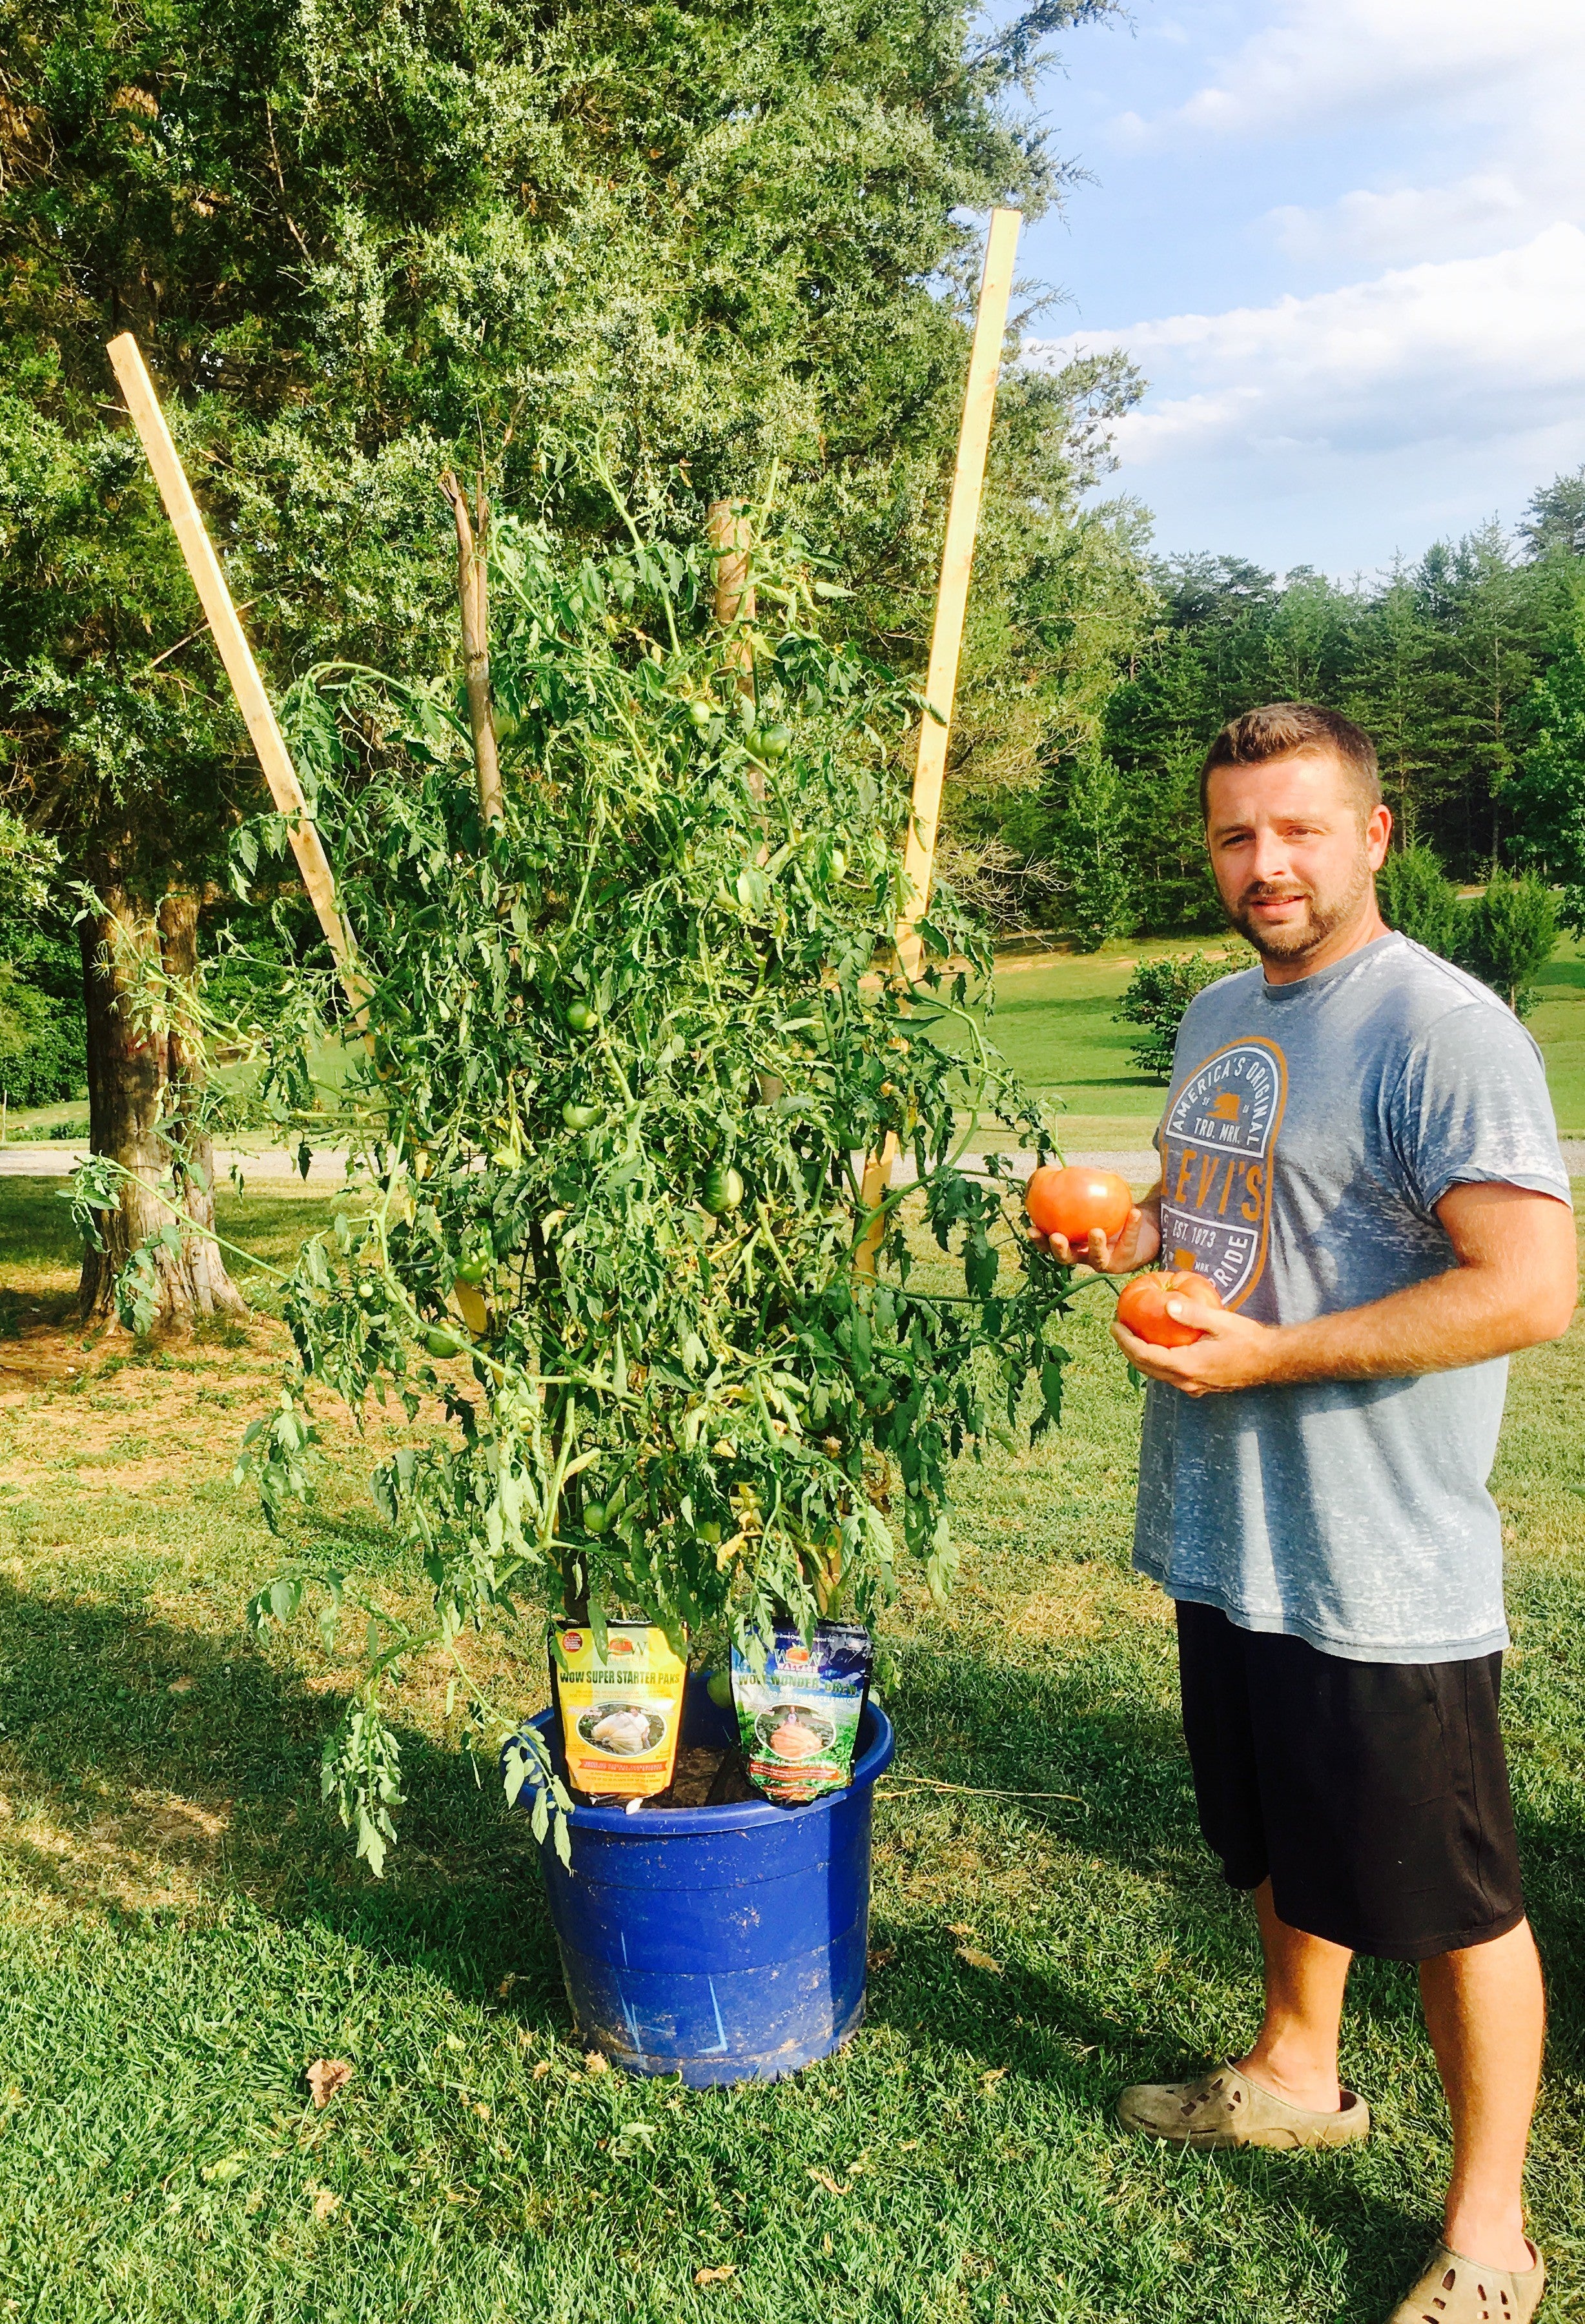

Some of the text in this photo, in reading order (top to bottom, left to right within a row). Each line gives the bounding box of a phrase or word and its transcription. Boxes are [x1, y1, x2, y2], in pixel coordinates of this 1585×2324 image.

[1172, 1057, 1271, 1146] AMERICA'S ORIGINAL
[1194, 1117, 1240, 1145] TRD. MRK.
[1161, 1143, 1263, 1222] LEVI'S
[1172, 1219, 1216, 1249] EST. 1873
[560, 1670, 680, 1685] WOW SUPER STARTER PAKS
[771, 1675, 820, 1689] WONDER
